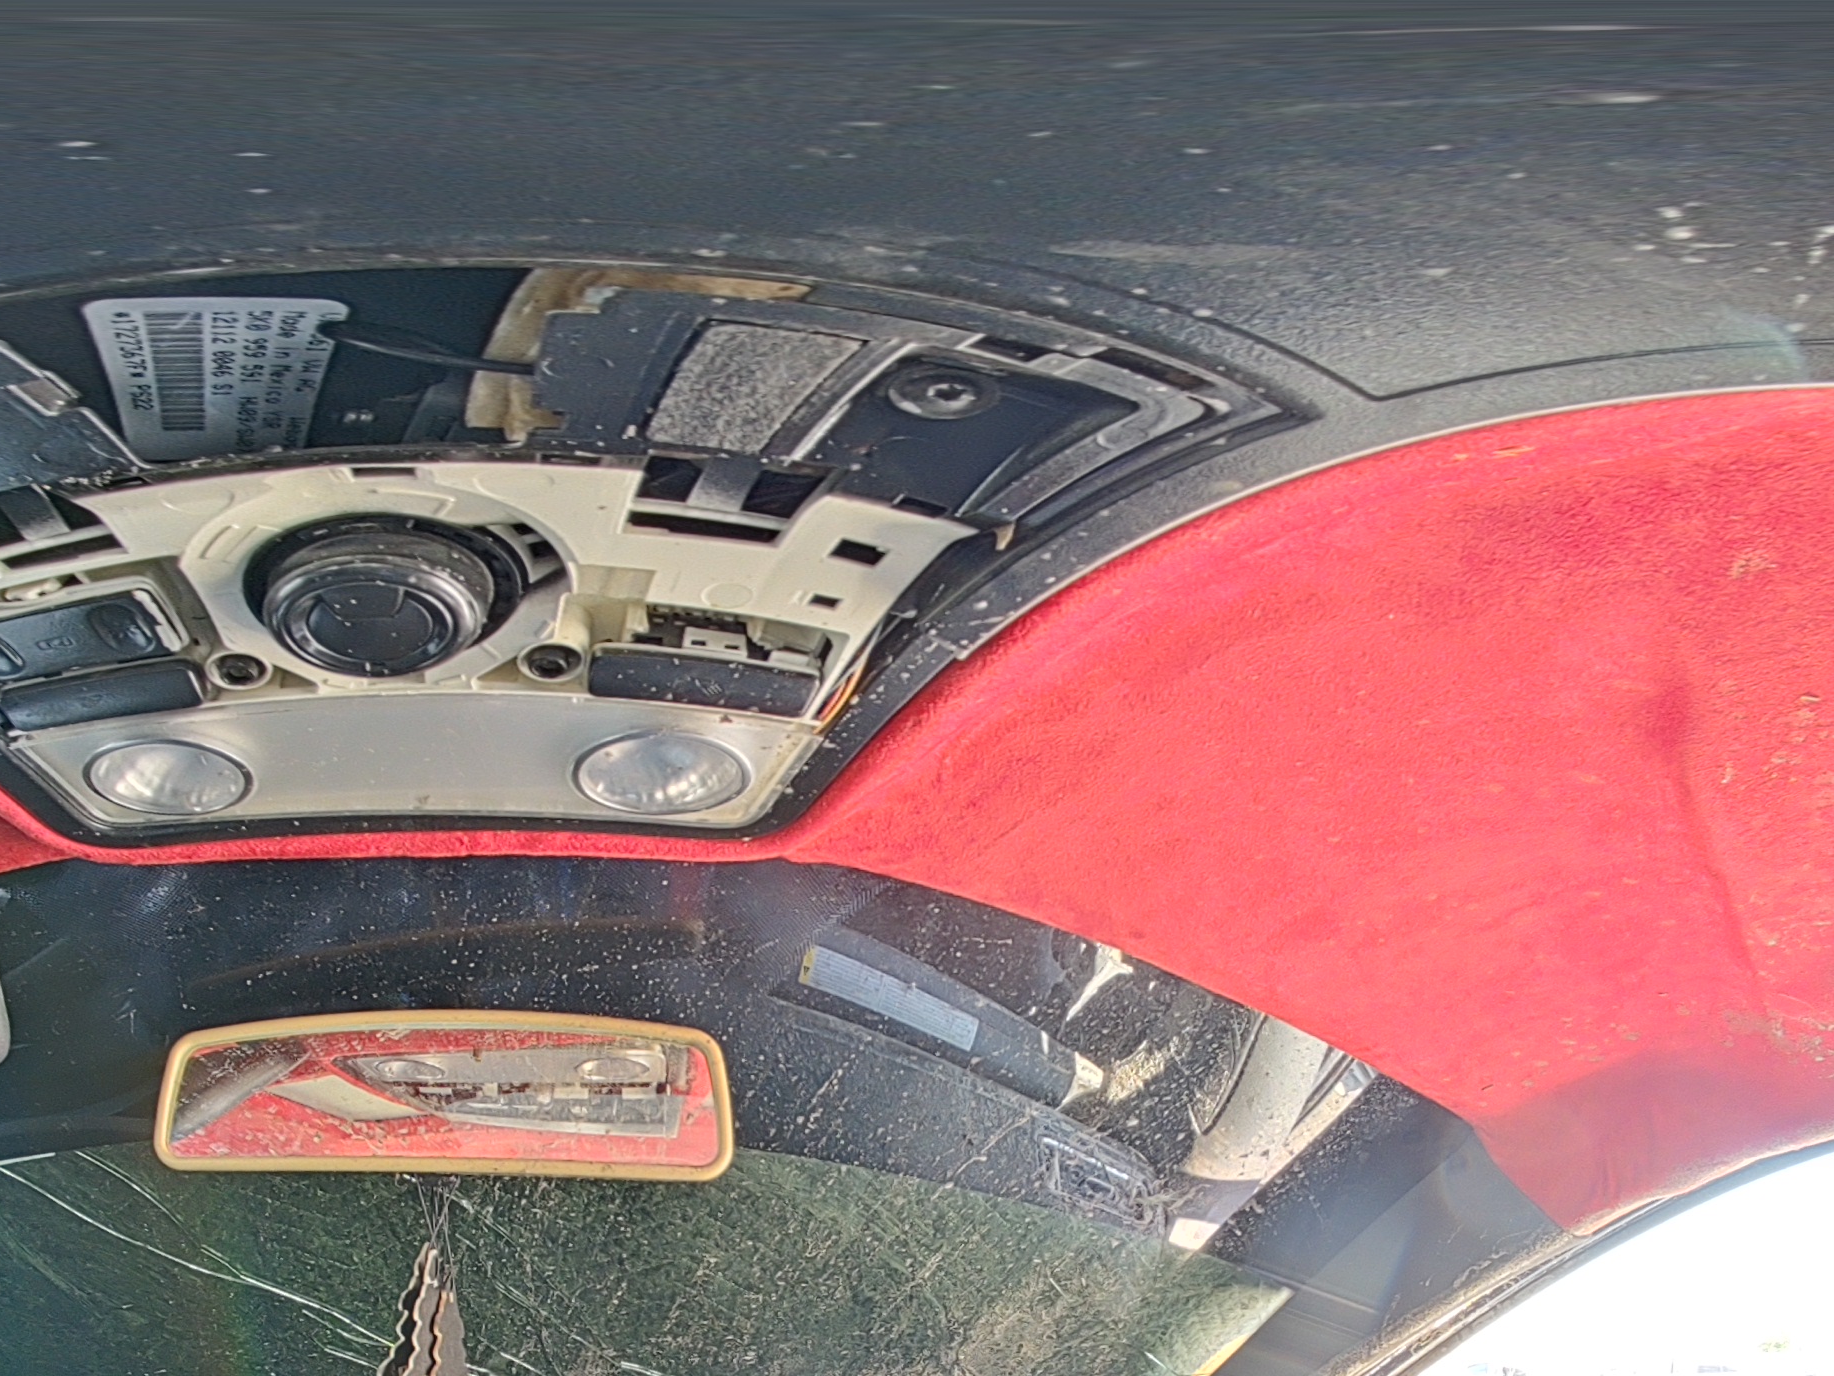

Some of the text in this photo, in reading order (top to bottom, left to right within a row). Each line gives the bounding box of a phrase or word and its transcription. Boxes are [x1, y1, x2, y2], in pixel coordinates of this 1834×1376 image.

[210, 309, 239, 345] 12112
[245, 310, 274, 332] 5K0
[277, 310, 309, 339] Made
[243, 337, 269, 359] 959
[273, 345, 294, 360] in
[299, 358, 321, 374] VW
[265, 363, 293, 405] Mexico
[131, 383, 155, 412] PS22
